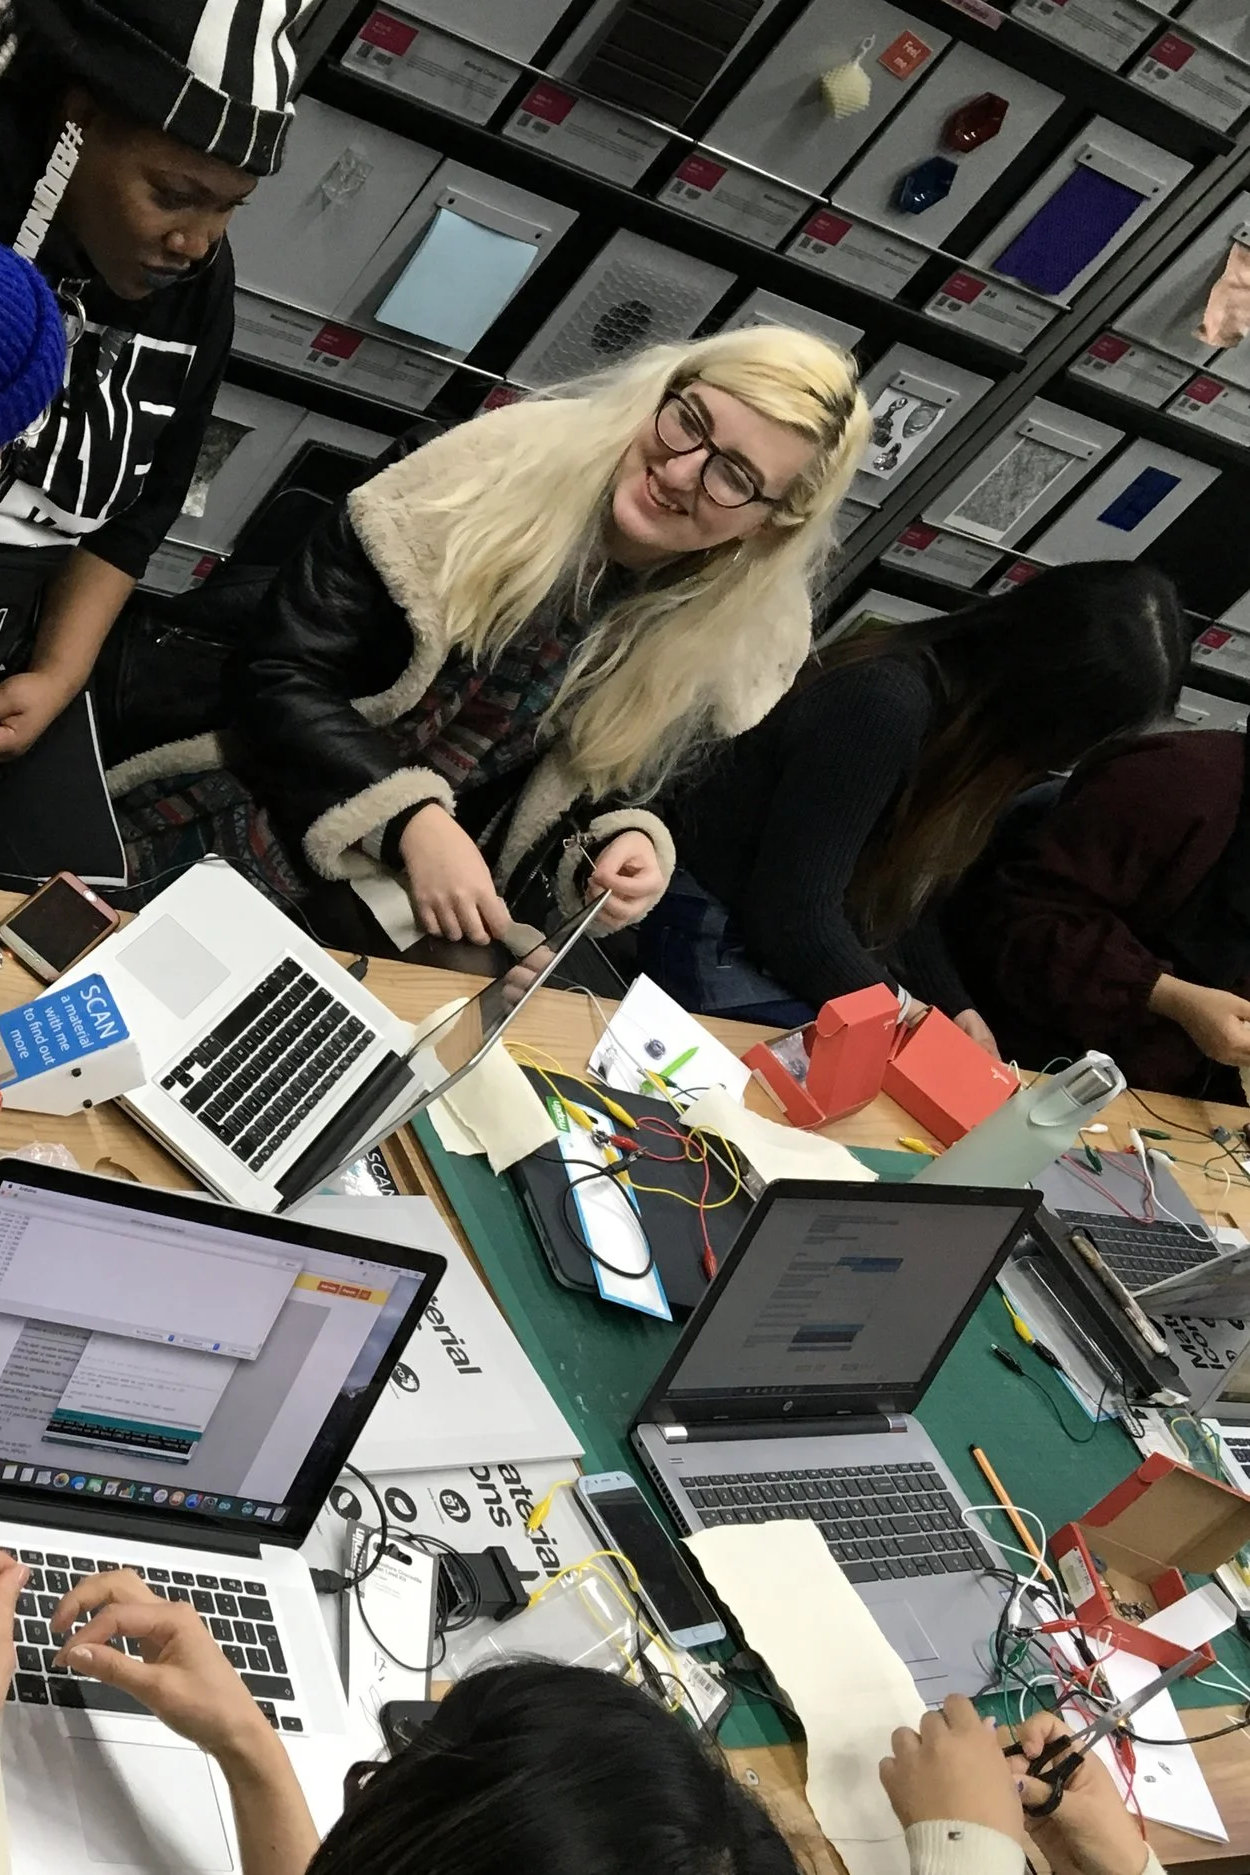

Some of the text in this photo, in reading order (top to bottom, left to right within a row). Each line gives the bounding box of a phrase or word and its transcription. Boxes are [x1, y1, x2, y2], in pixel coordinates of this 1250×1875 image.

[23, 1007, 56, 1065] to find out
[44, 1006, 71, 1052] with me
[60, 994, 95, 1049] a material
[80, 984, 119, 1040] SCAN
[9, 1029, 30, 1059] more
[424, 1296, 483, 1376] erial
[1181, 1315, 1227, 1371] Icon
[469, 1466, 512, 1528] ons
[499, 1464, 562, 1578] aterial
